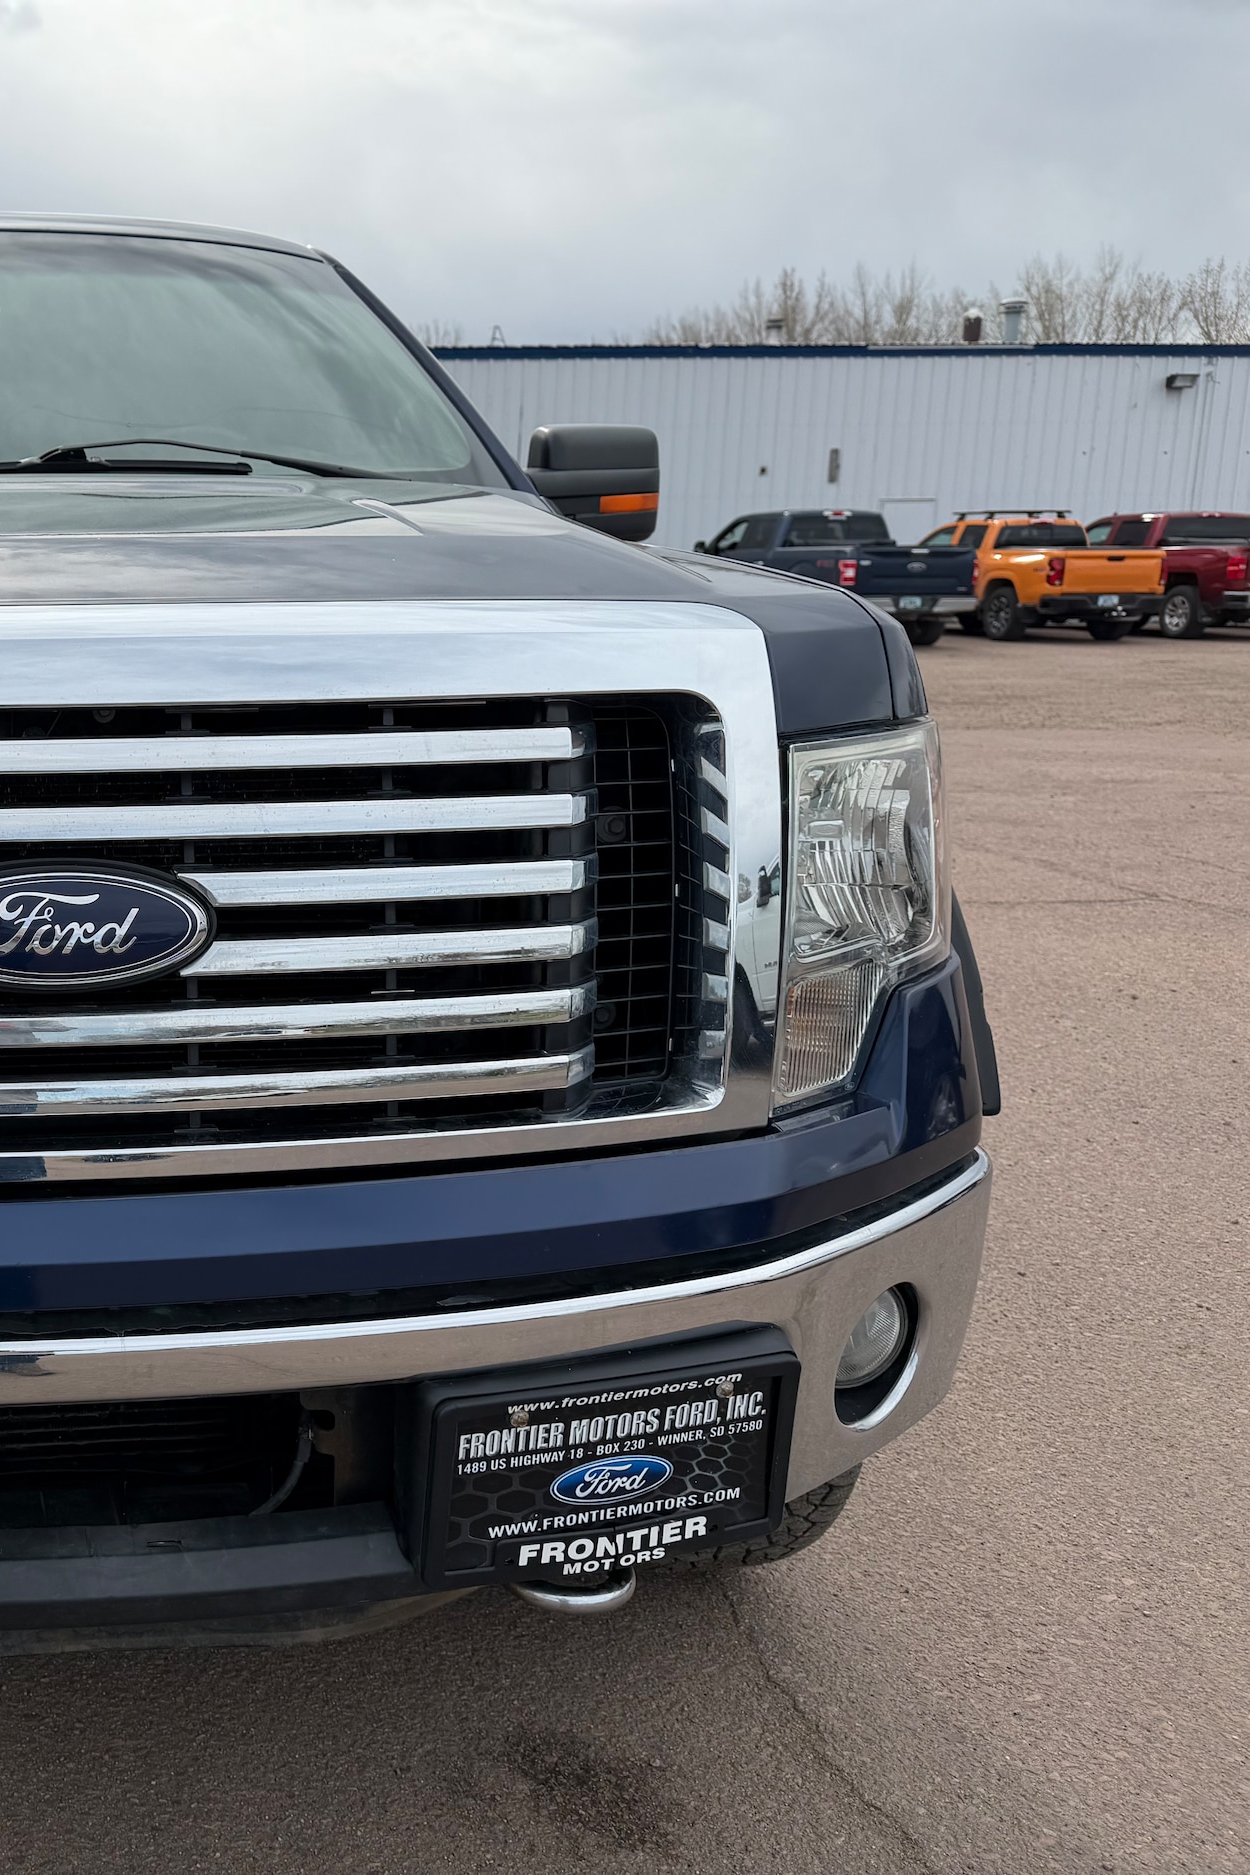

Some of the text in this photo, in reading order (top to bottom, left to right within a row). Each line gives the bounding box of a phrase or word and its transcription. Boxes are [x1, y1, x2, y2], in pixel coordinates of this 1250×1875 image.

[507, 1373, 742, 1414] www.frontiermotors.com
[457, 1461, 487, 1475] 1489
[490, 1458, 506, 1470] US
[510, 1451, 565, 1467] HIGHWAY
[570, 1448, 584, 1460] 18
[596, 1442, 620, 1456] BOX
[623, 1438, 646, 1451] 230
[710, 1425, 725, 1438] SD
[728, 1419, 763, 1435] 57580
[458, 1391, 766, 1460] FRONTIER MOTORS FORD, INC.
[575, 1463, 647, 1498] Ford
[487, 1487, 742, 1539] WWW.FRONTIERMOTORS.COM
[518, 1516, 708, 1567] FRONTIER
